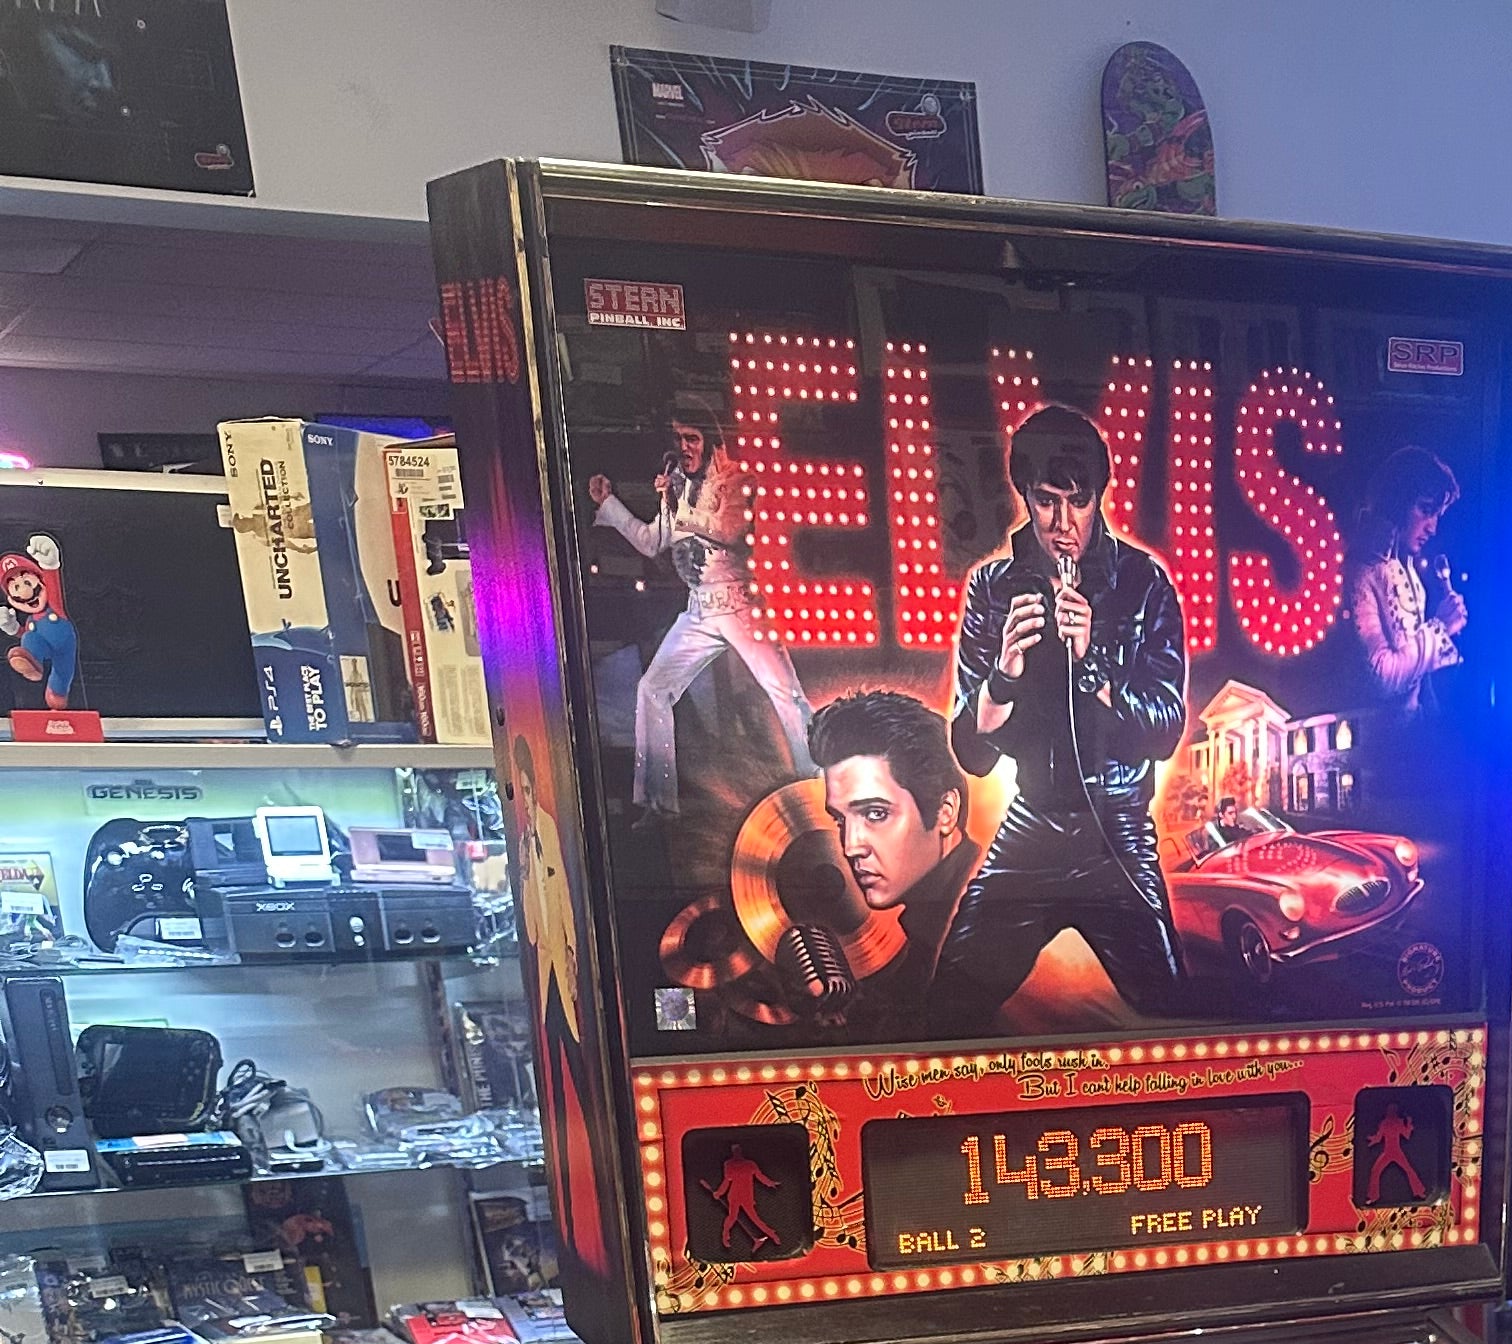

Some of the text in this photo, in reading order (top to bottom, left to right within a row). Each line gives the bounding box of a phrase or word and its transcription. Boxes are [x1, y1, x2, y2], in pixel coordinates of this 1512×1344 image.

[652, 82, 684, 100] MARVEL
[588, 283, 681, 315] STERN
[1391, 341, 1460, 364] SRP
[223, 431, 239, 478] SONY
[307, 433, 333, 447] SONY
[387, 455, 431, 468] 5784524
[276, 460, 295, 531] COLLECTION
[261, 457, 293, 600] UNCHARTED
[308, 664, 328, 731] TO PLAY
[90, 784, 199, 800] GENESIS
[0, 867, 29, 883] ELDA
[256, 901, 296, 912] XBOX
[864, 1067, 917, 1100] Wise
[921, 1068, 951, 1086] men
[988, 1052, 1017, 1077] only
[1019, 1051, 1053, 1075] fools
[1057, 1052, 1090, 1070] rush
[1017, 1072, 1062, 1100] But
[1065, 1072, 1079, 1097] I
[1113, 1071, 1142, 1095] help
[1144, 1066, 1190, 1096] falling
[1190, 1069, 1206, 1088] in
[1207, 1065, 1235, 1088] love
[1236, 1060, 1265, 1083] with
[1130, 1203, 1263, 1237] FREE PLAY
[898, 1226, 988, 1256] BALL 2
